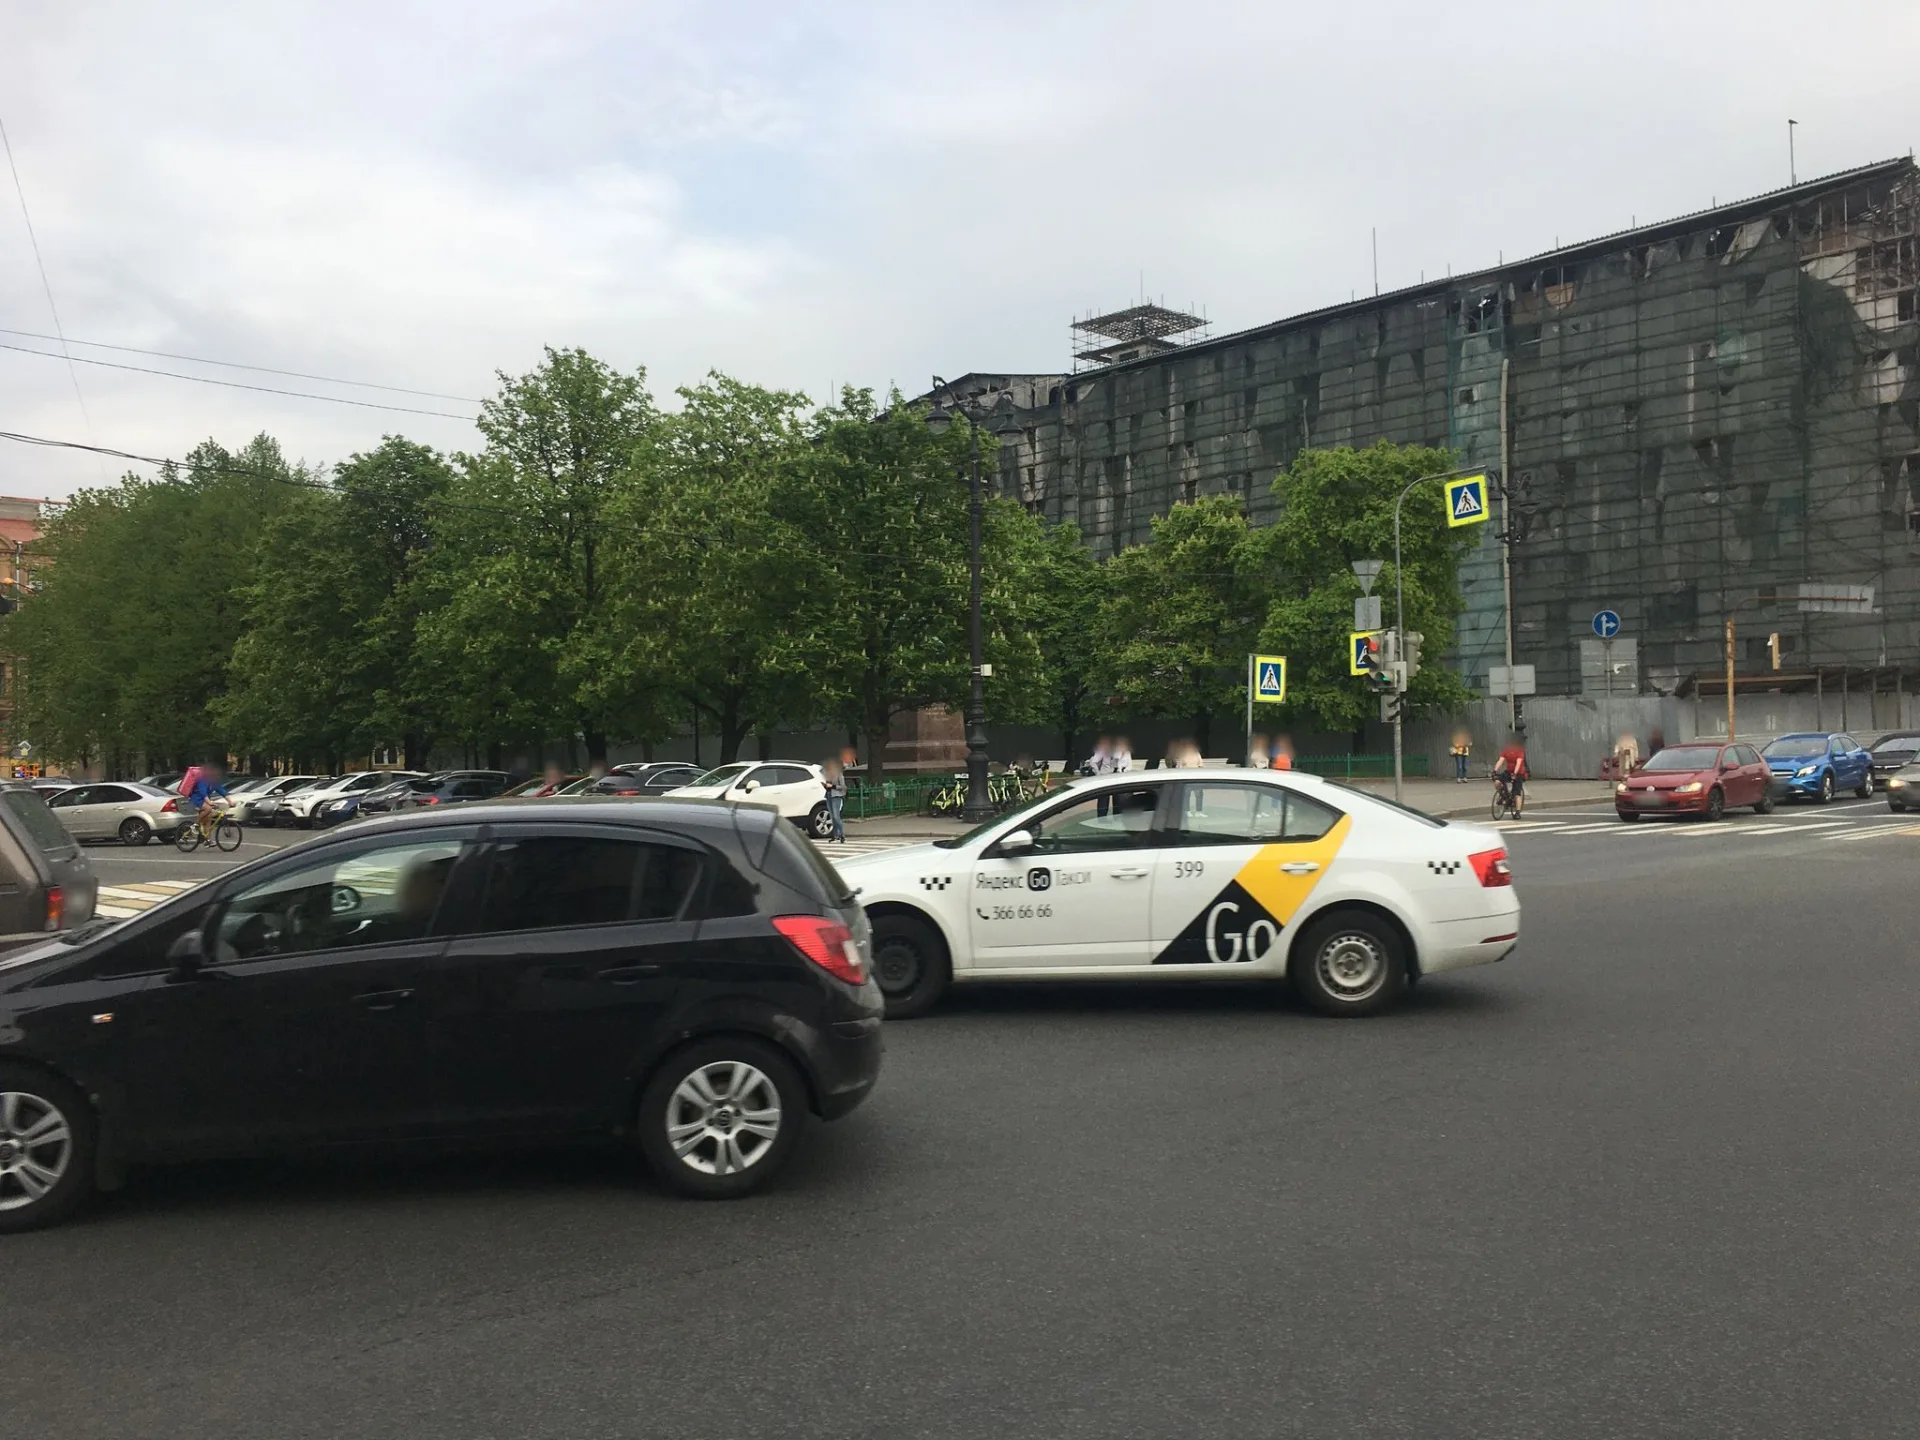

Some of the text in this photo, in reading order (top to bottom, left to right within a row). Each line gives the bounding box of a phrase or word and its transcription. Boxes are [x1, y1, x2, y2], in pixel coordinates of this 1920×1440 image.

[1174, 861, 1204, 878] 399
[976, 869, 1091, 890] Яндекс Go Такси
[993, 904, 1053, 920] 366 66 66
[1205, 901, 1277, 963] Go
